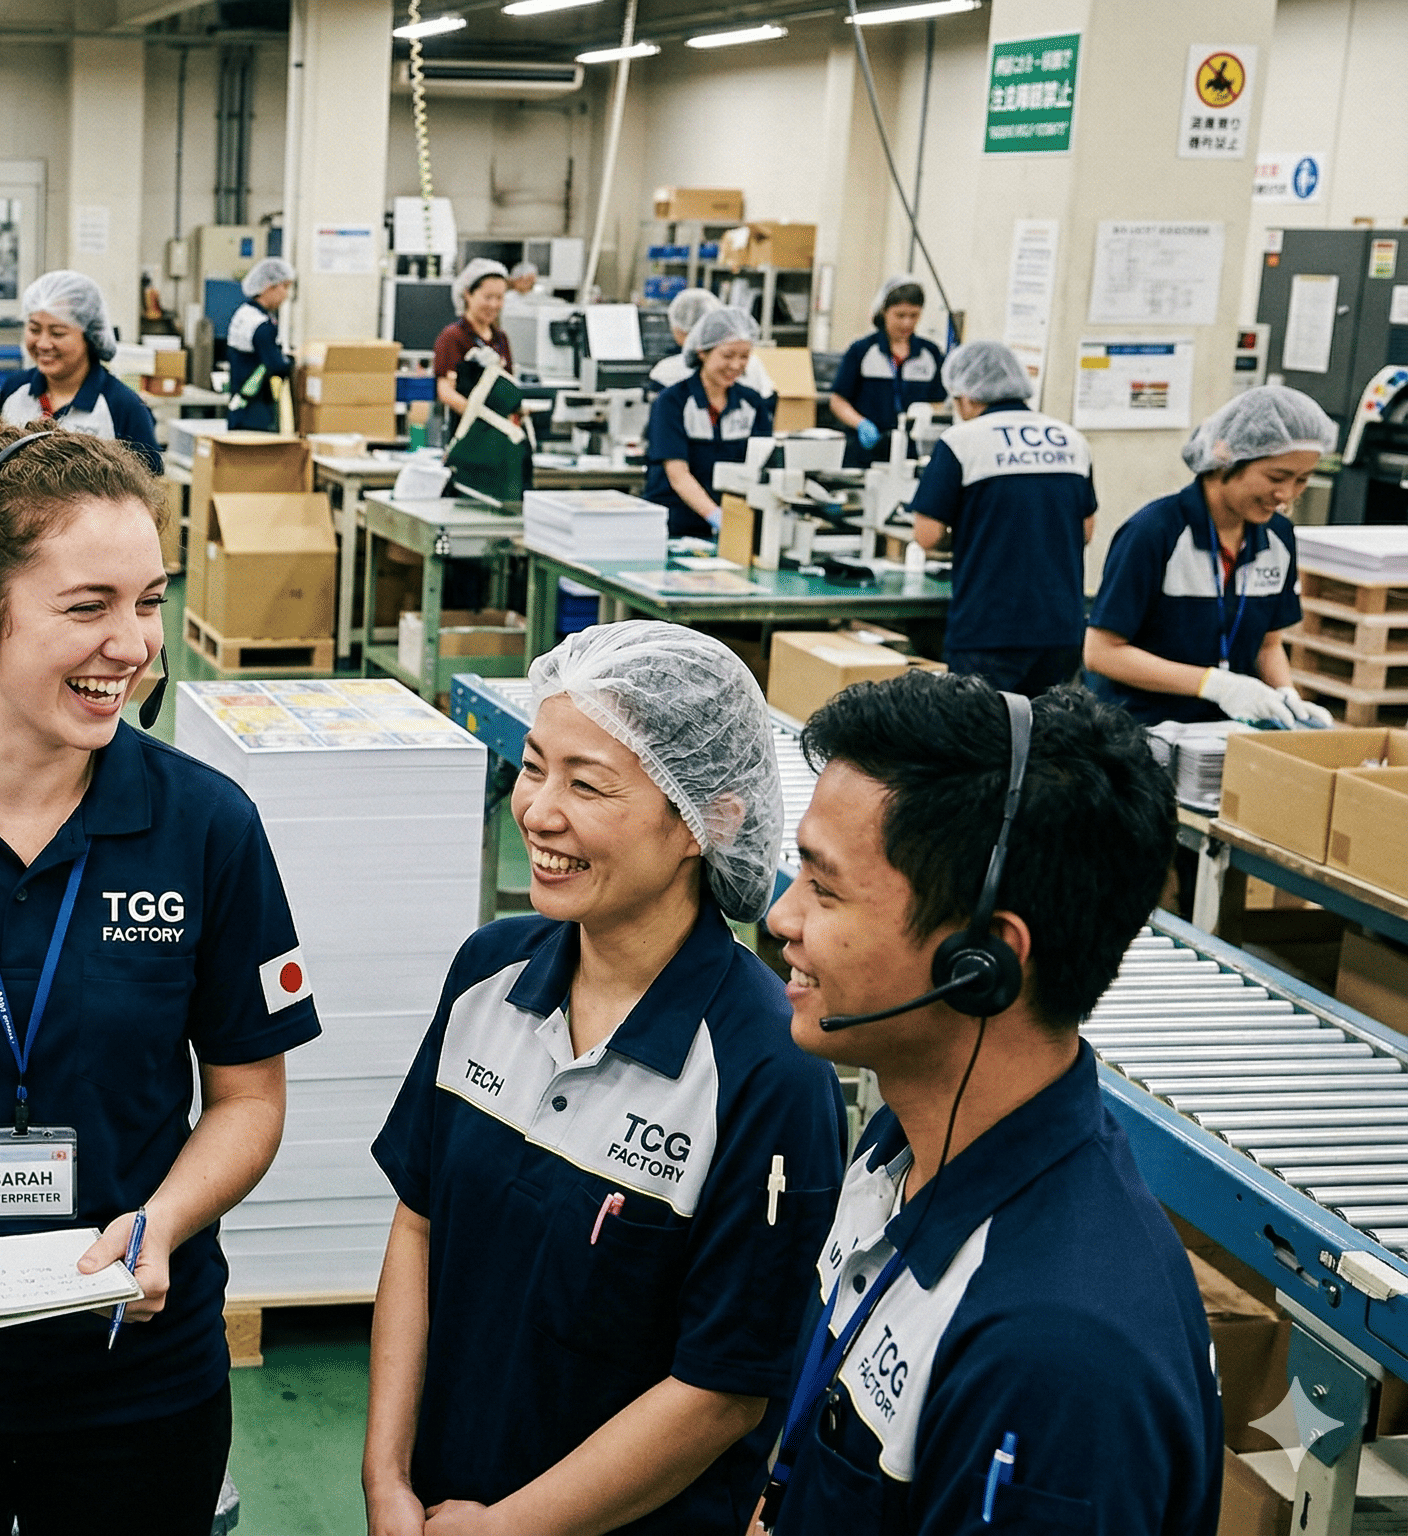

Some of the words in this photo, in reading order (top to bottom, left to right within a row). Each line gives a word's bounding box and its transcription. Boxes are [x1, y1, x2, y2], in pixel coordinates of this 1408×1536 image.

[993, 426, 1068, 447] TCG
[996, 451, 1075, 467] FACTORY
[102, 891, 185, 923] TGG
[102, 926, 185, 943] FACTORY
[464, 1059, 506, 1096] TECH
[623, 1112, 692, 1163] TCG
[606, 1143, 685, 1184] FACTORY
[872, 1324, 908, 1398] TCG
